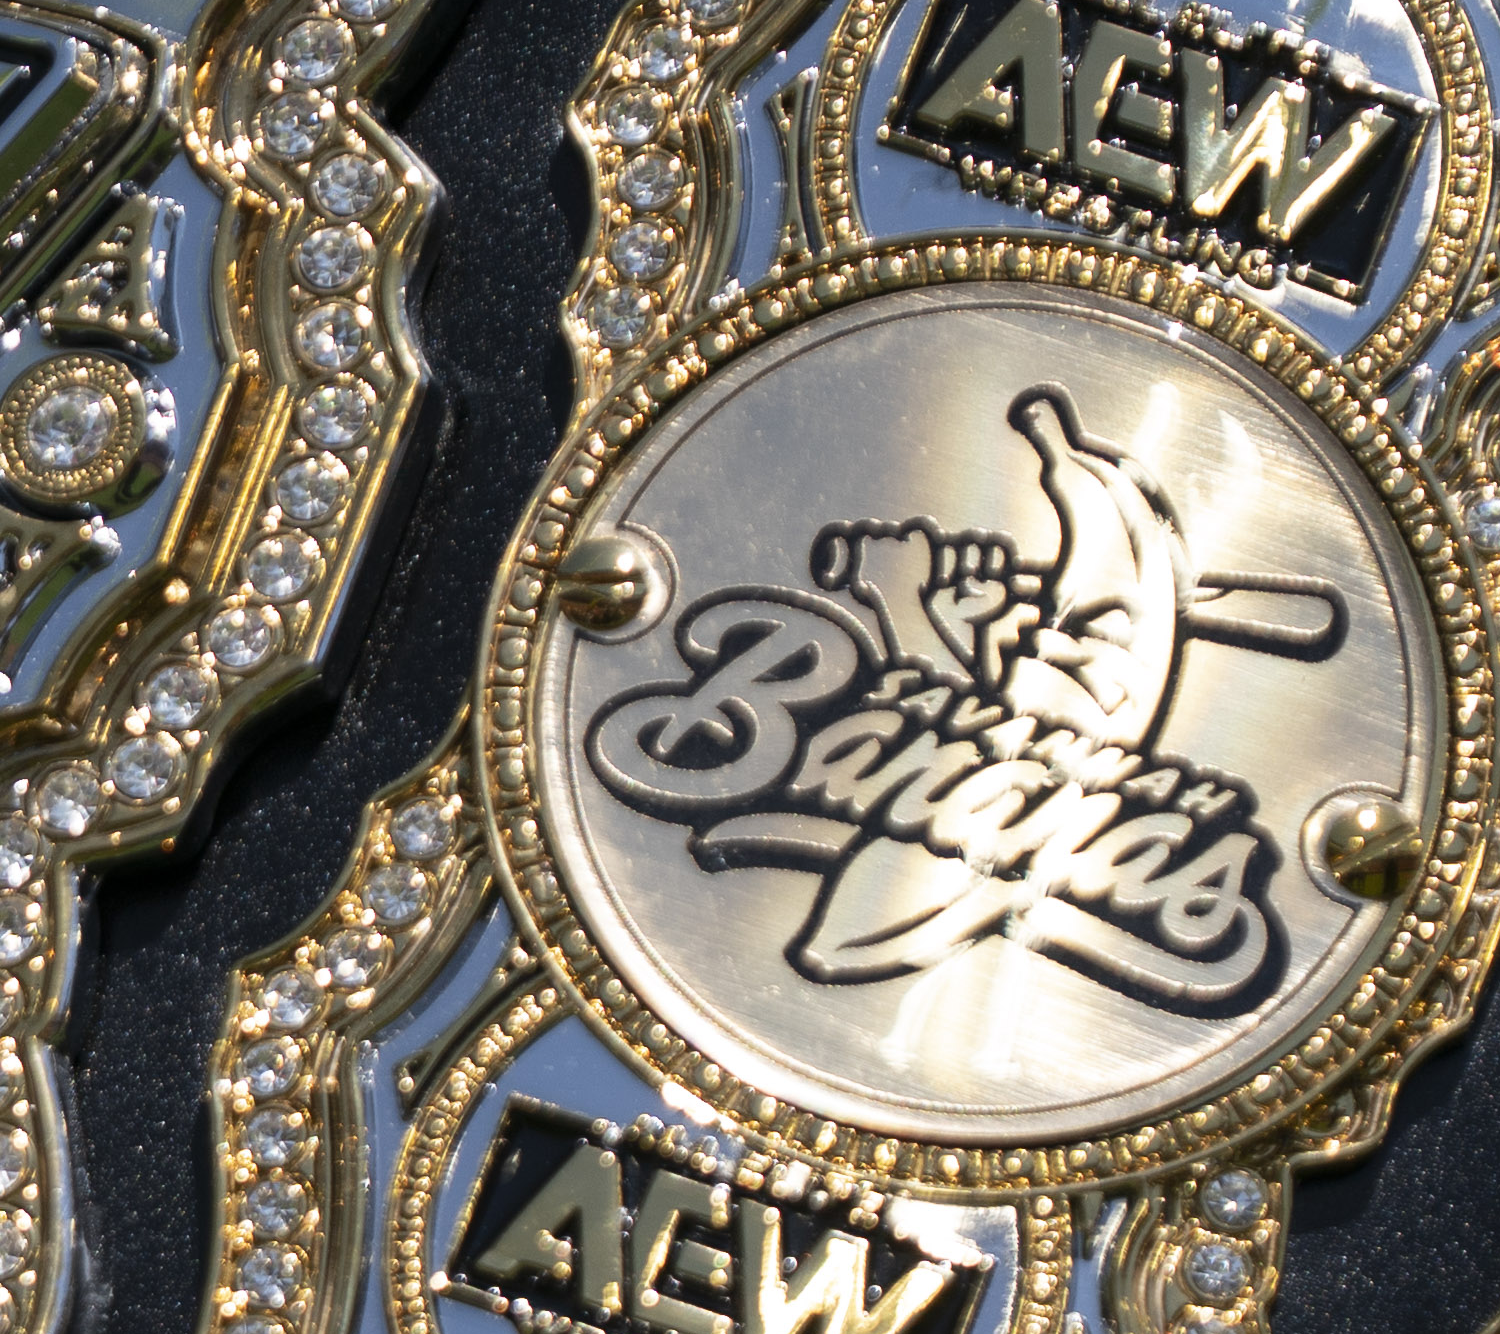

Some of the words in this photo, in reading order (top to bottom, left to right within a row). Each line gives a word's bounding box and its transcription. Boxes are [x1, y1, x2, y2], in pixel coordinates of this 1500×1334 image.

[958, 152, 1290, 289] WRESTLING
[592, 591, 1275, 1005] Bananas
[861, 667, 1240, 817] SAVANNAH
